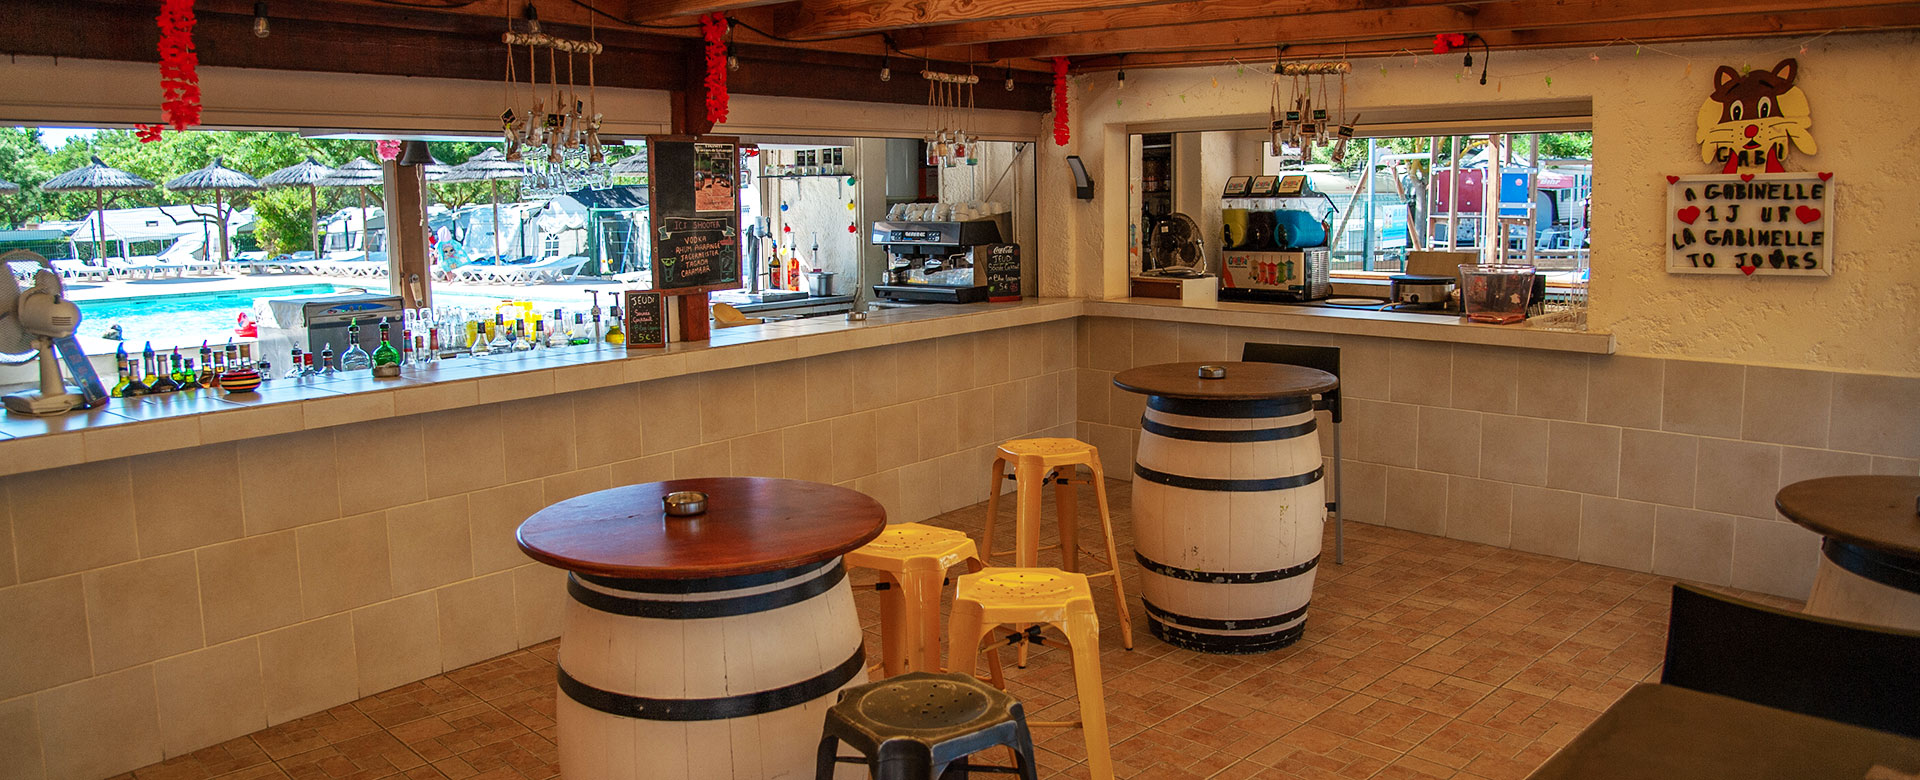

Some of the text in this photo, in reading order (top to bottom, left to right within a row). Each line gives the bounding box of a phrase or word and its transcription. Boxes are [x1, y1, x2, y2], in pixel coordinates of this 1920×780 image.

[1717, 143, 1784, 167] GABI
[1685, 183, 1824, 201] A GABINELLE
[674, 220, 721, 230] ICI SHOOTER
[684, 235, 707, 245] VODKA
[1672, 227, 1824, 250] LA GABINELLE
[675, 245, 693, 254] RHUM
[685, 258, 709, 269] TAGADA
[1686, 252, 1715, 268] TO
[630, 295, 655, 306] JEUDI
